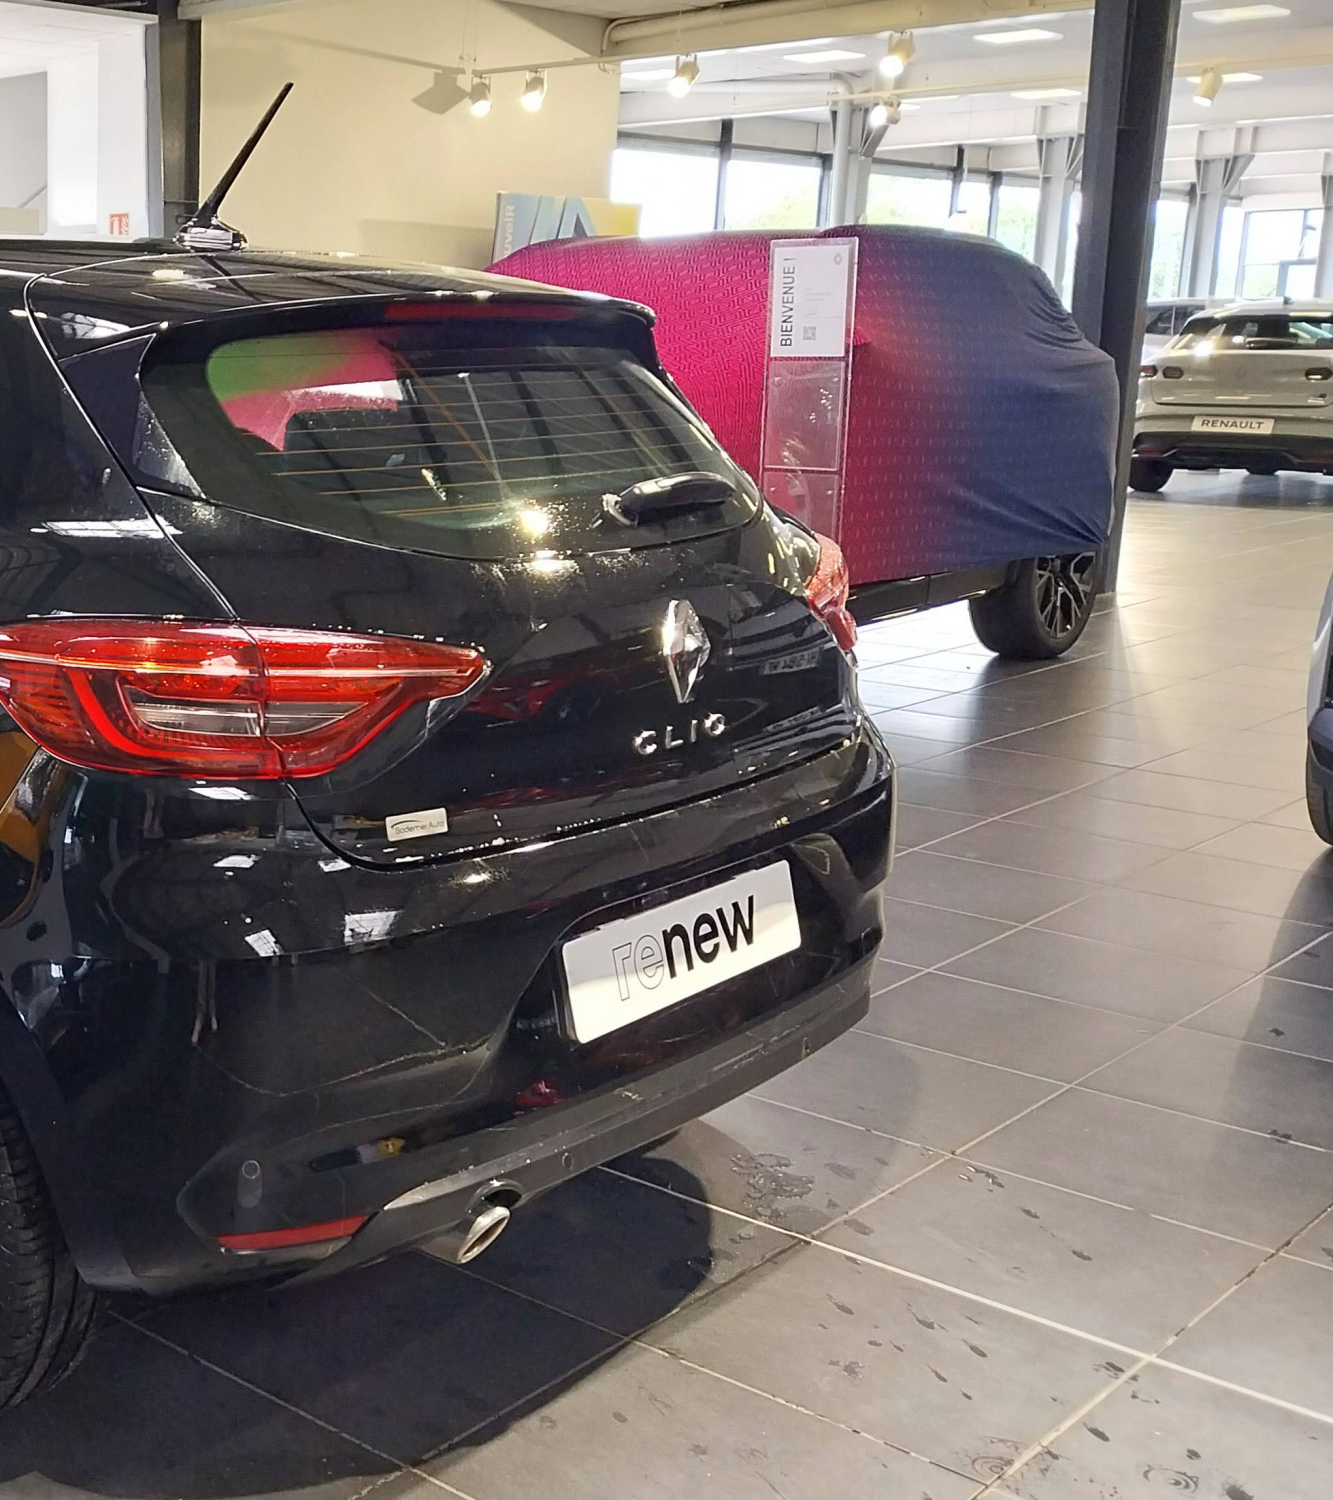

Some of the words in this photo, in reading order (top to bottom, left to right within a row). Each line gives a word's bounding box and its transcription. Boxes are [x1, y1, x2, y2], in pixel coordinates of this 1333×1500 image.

[780, 266, 795, 347] BIENVENUE
[1201, 419, 1264, 429] RENAULT
[632, 713, 725, 755] CLIO
[612, 895, 754, 1001] renew
